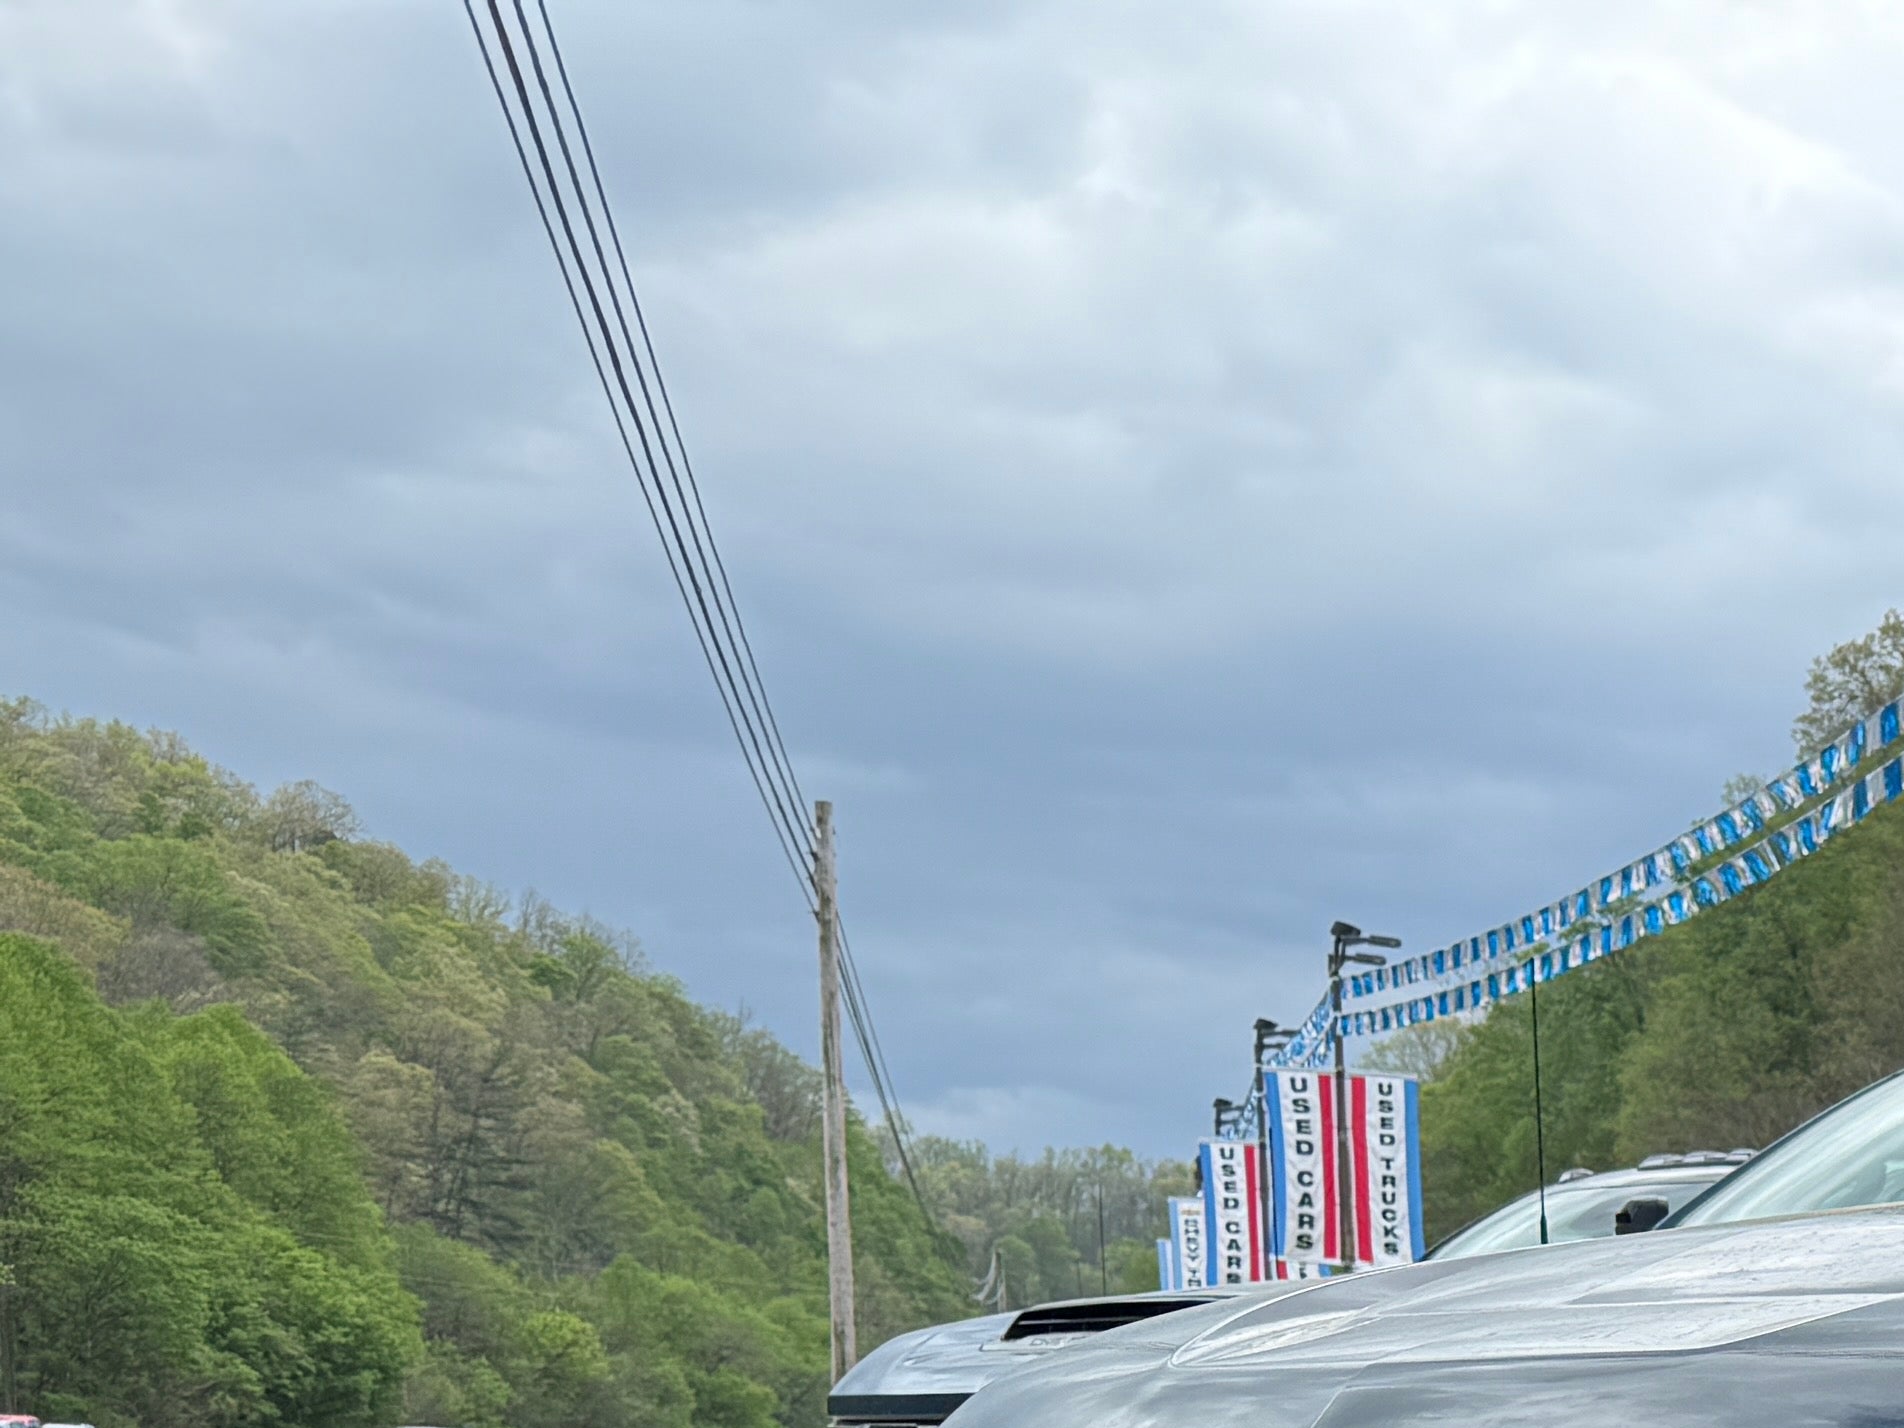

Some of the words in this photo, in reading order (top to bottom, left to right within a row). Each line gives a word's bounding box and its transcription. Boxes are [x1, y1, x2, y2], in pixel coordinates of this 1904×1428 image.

[1290, 1076, 1314, 1156] USED
[1378, 1082, 1396, 1146] USED
[1219, 1147, 1239, 1209] USED
[1296, 1170, 1316, 1250] CARS
[1379, 1157, 1400, 1256] TRUCKS
[1225, 1220, 1242, 1284] CARS
